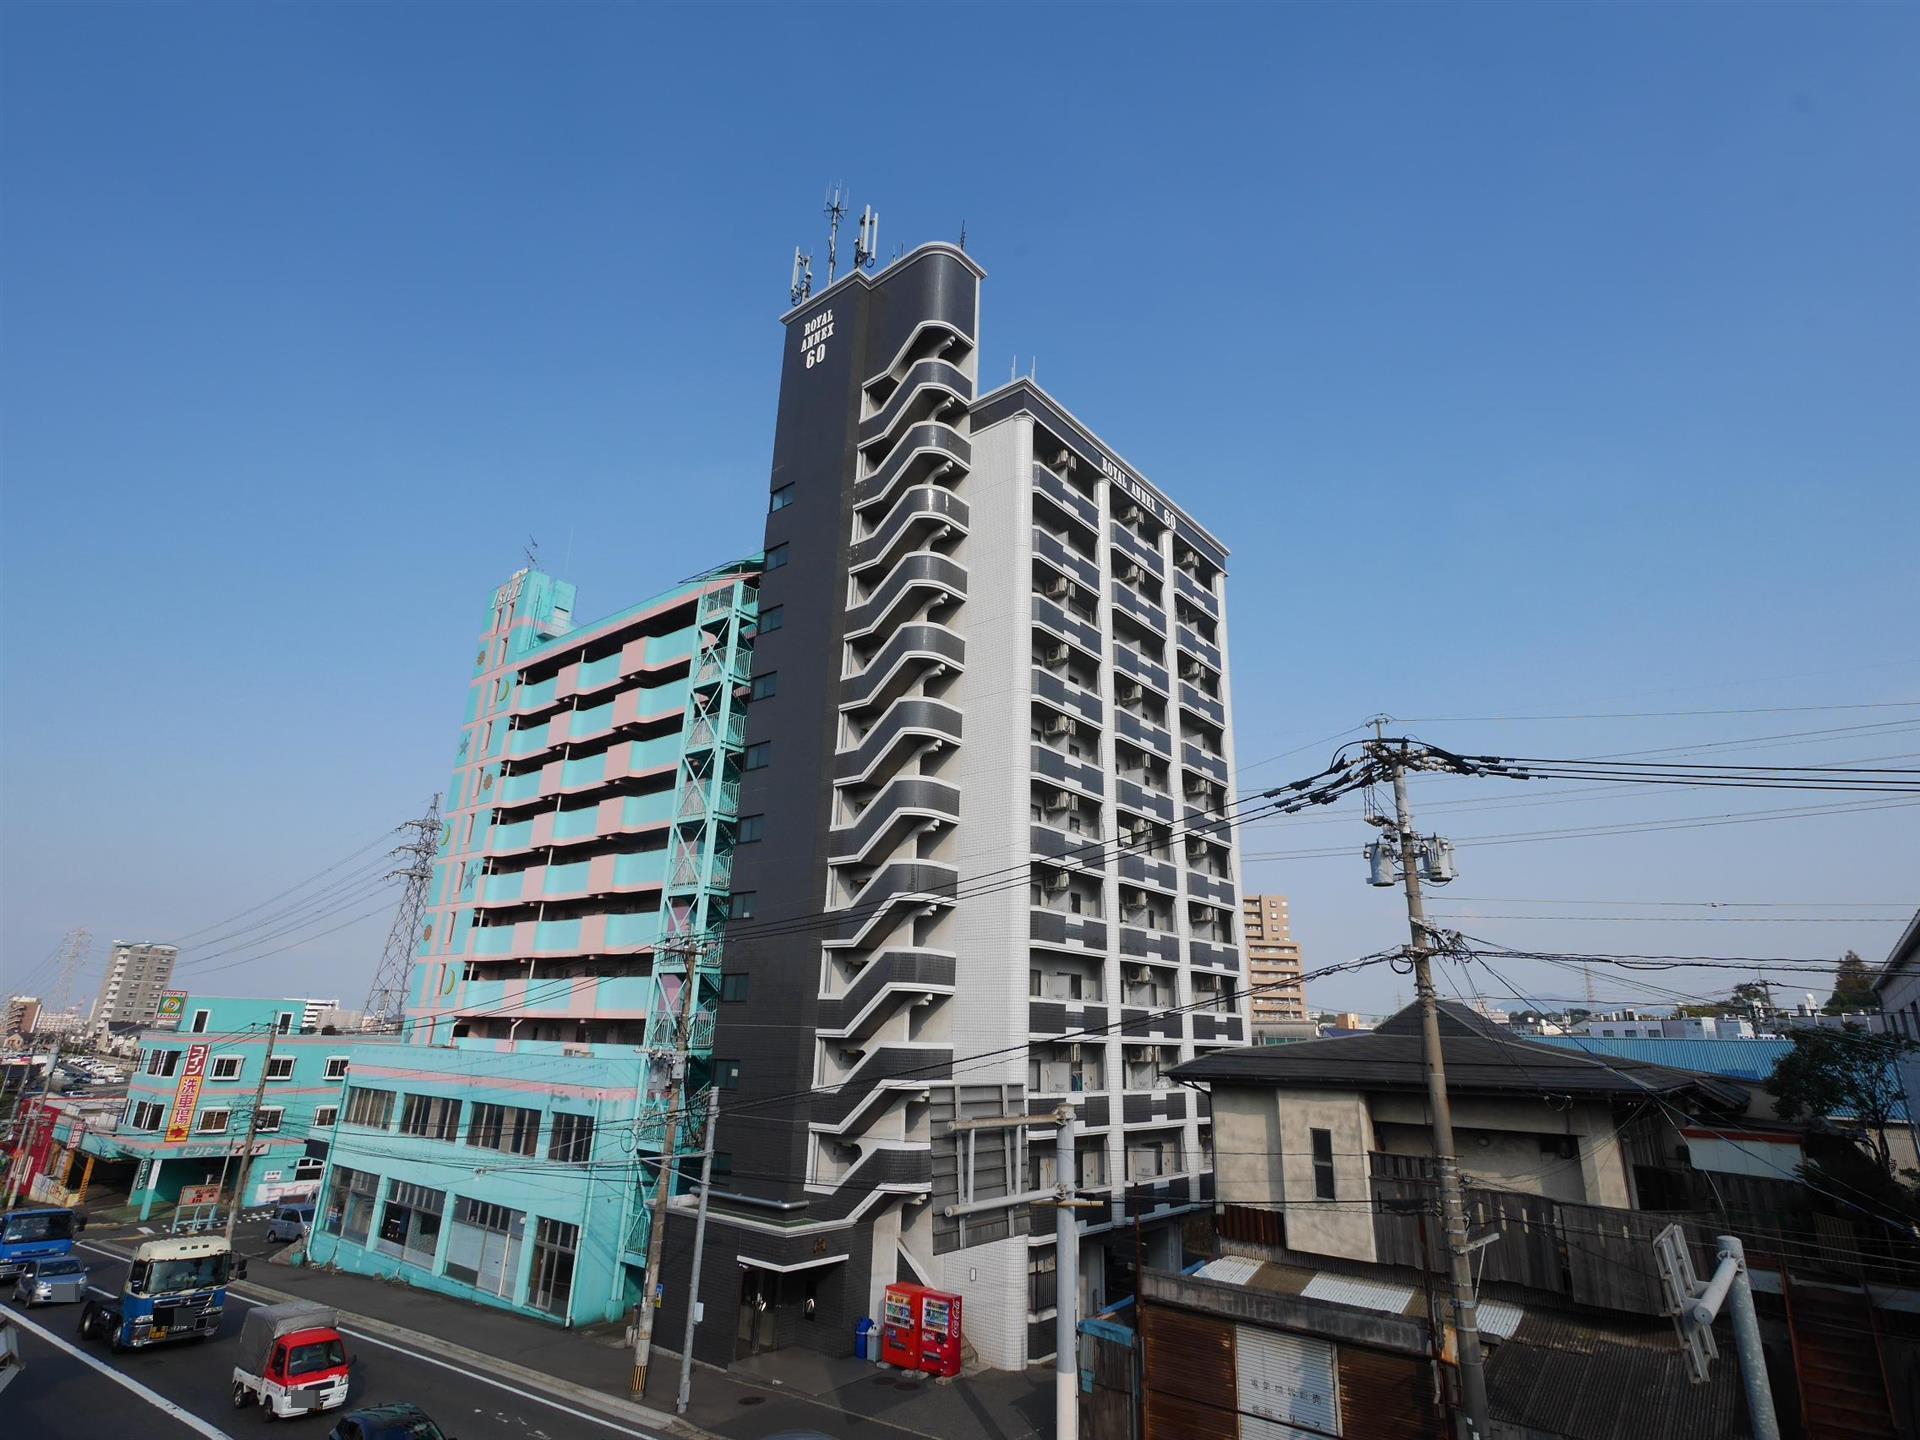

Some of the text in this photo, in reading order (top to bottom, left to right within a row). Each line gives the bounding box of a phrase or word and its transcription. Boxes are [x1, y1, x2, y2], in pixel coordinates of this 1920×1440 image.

[800, 322, 835, 353] ANNEX
[803, 309, 834, 337] ROYAL
[806, 343, 826, 369] 60
[1101, 457, 1177, 531] ROYAL ANNEX 60
